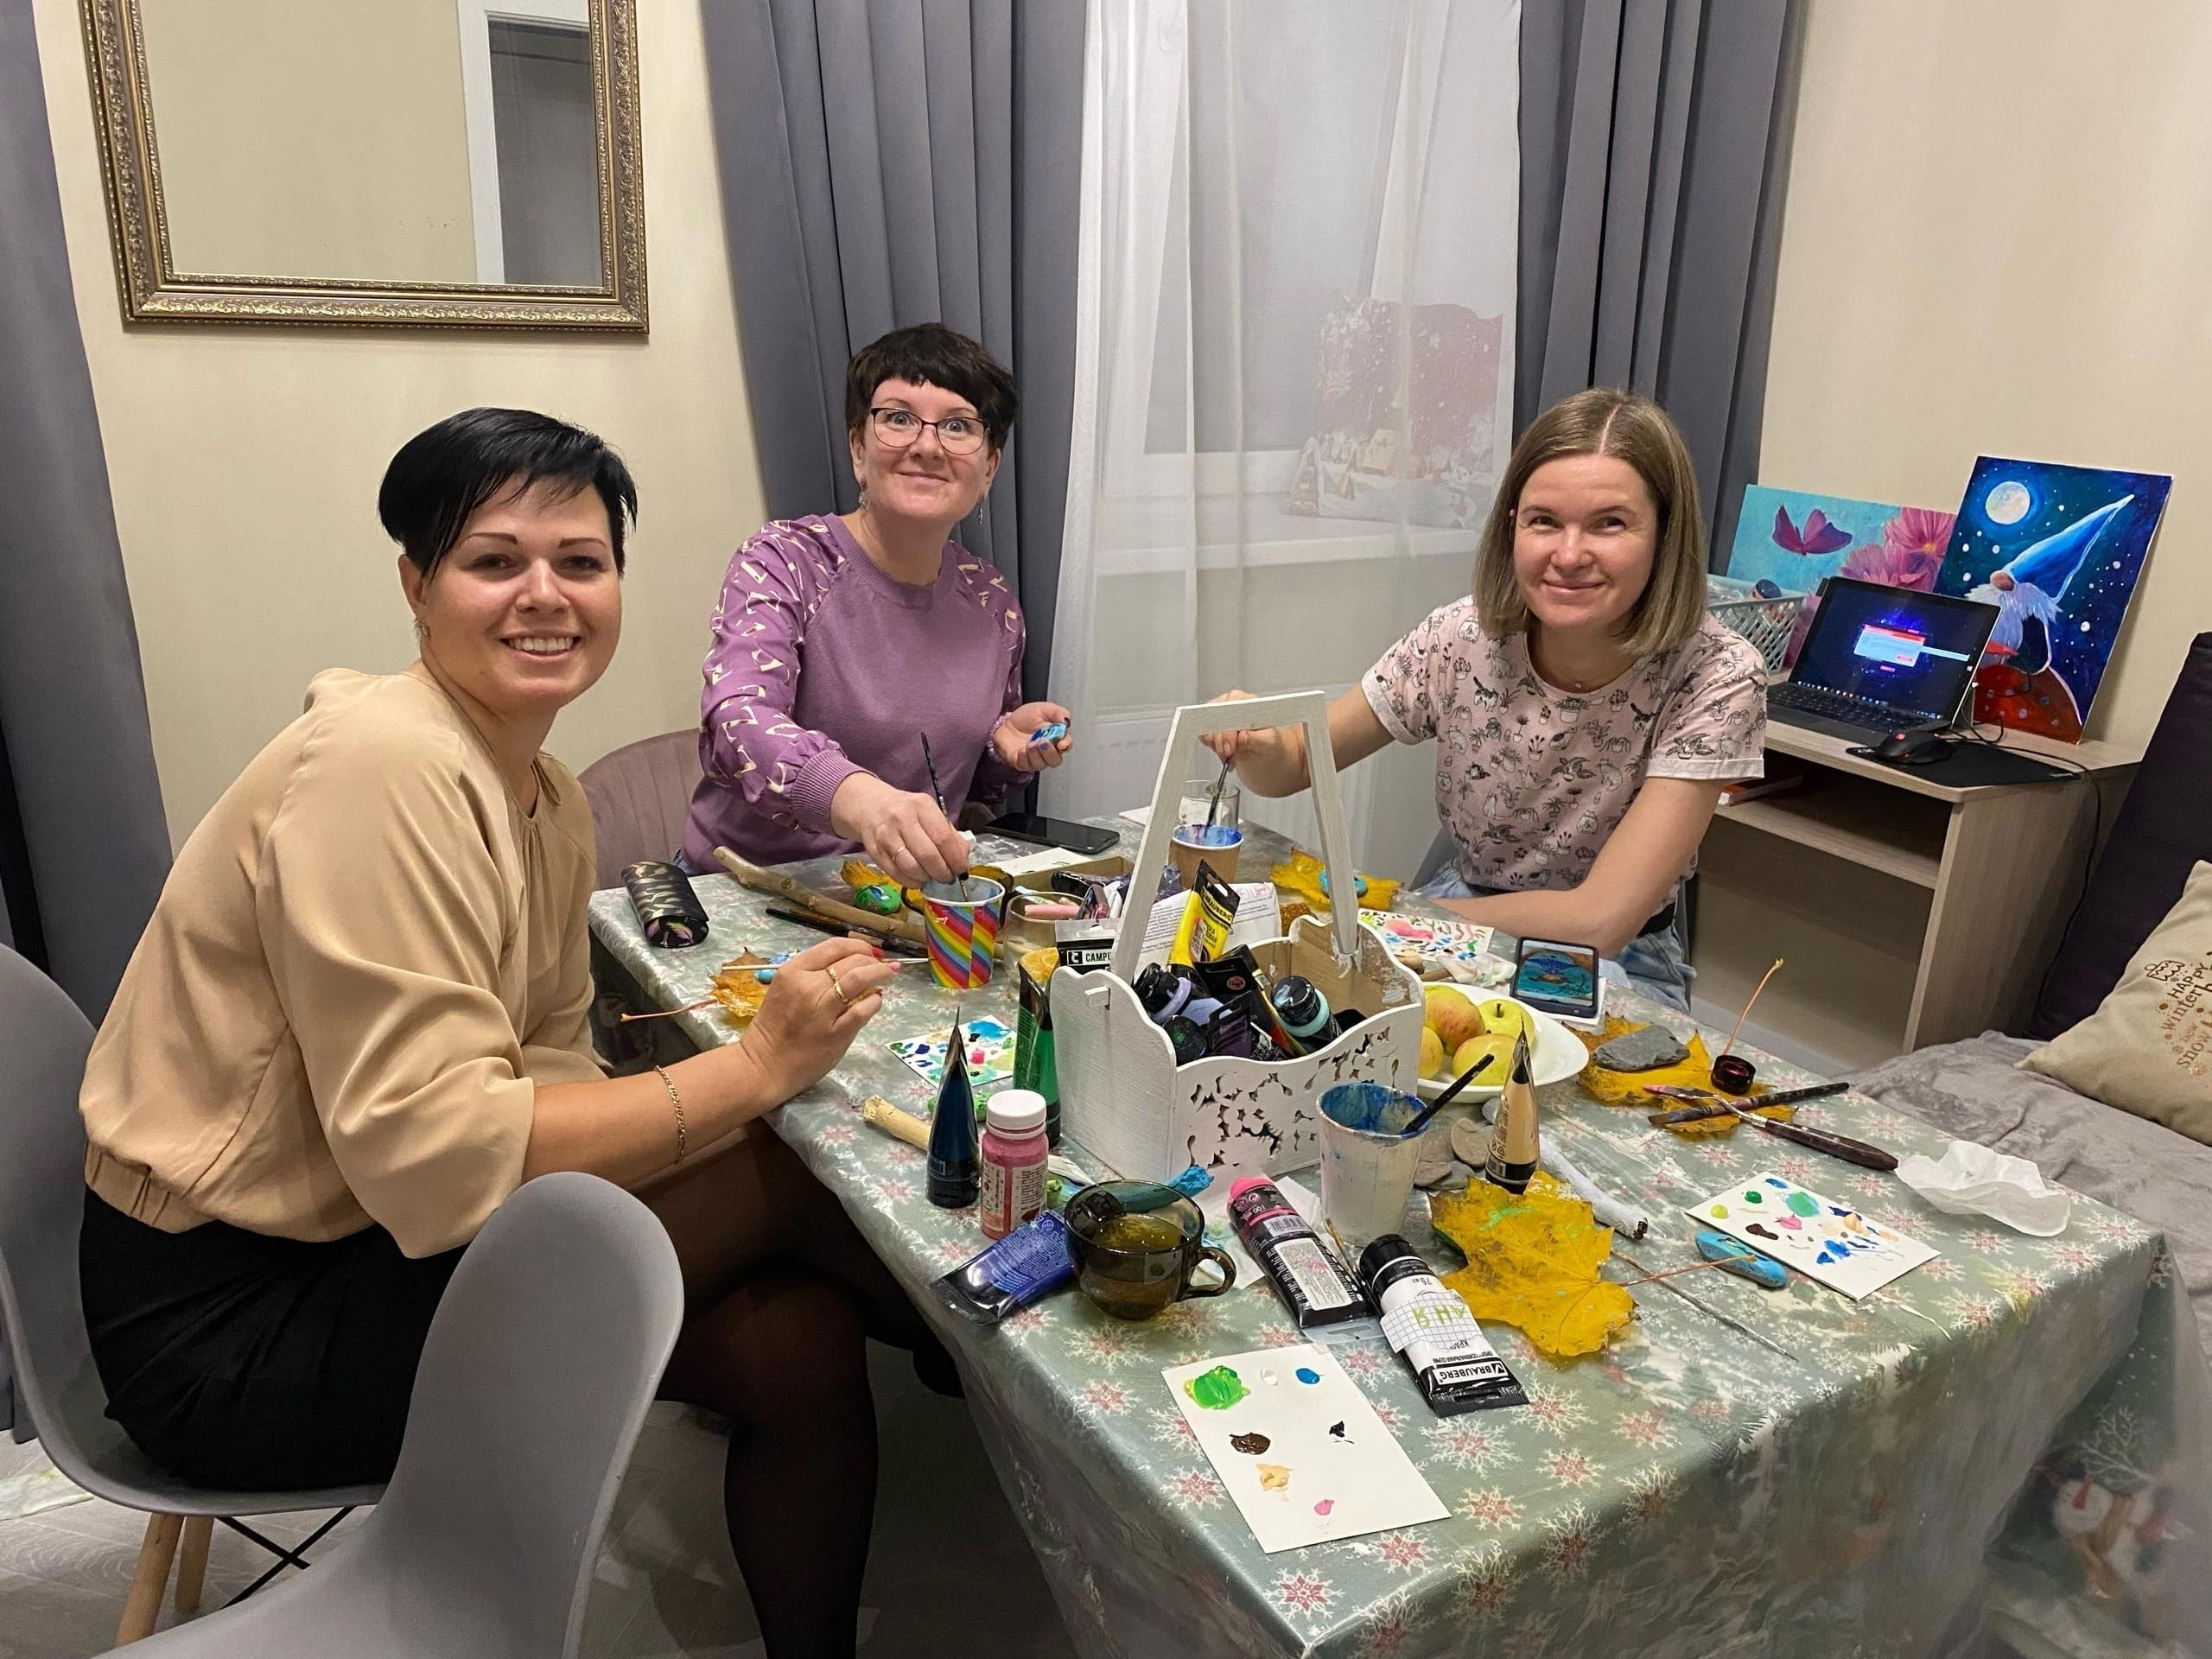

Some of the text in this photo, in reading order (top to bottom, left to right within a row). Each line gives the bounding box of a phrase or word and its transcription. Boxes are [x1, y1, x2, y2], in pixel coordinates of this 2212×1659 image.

[1205, 897, 1233, 921] BRAUBERG
[1085, 952, 1112, 962] CAMPU
[2167, 963, 2209, 999] HAPPY
[1440, 1363, 1492, 1380] BRAUBERG
